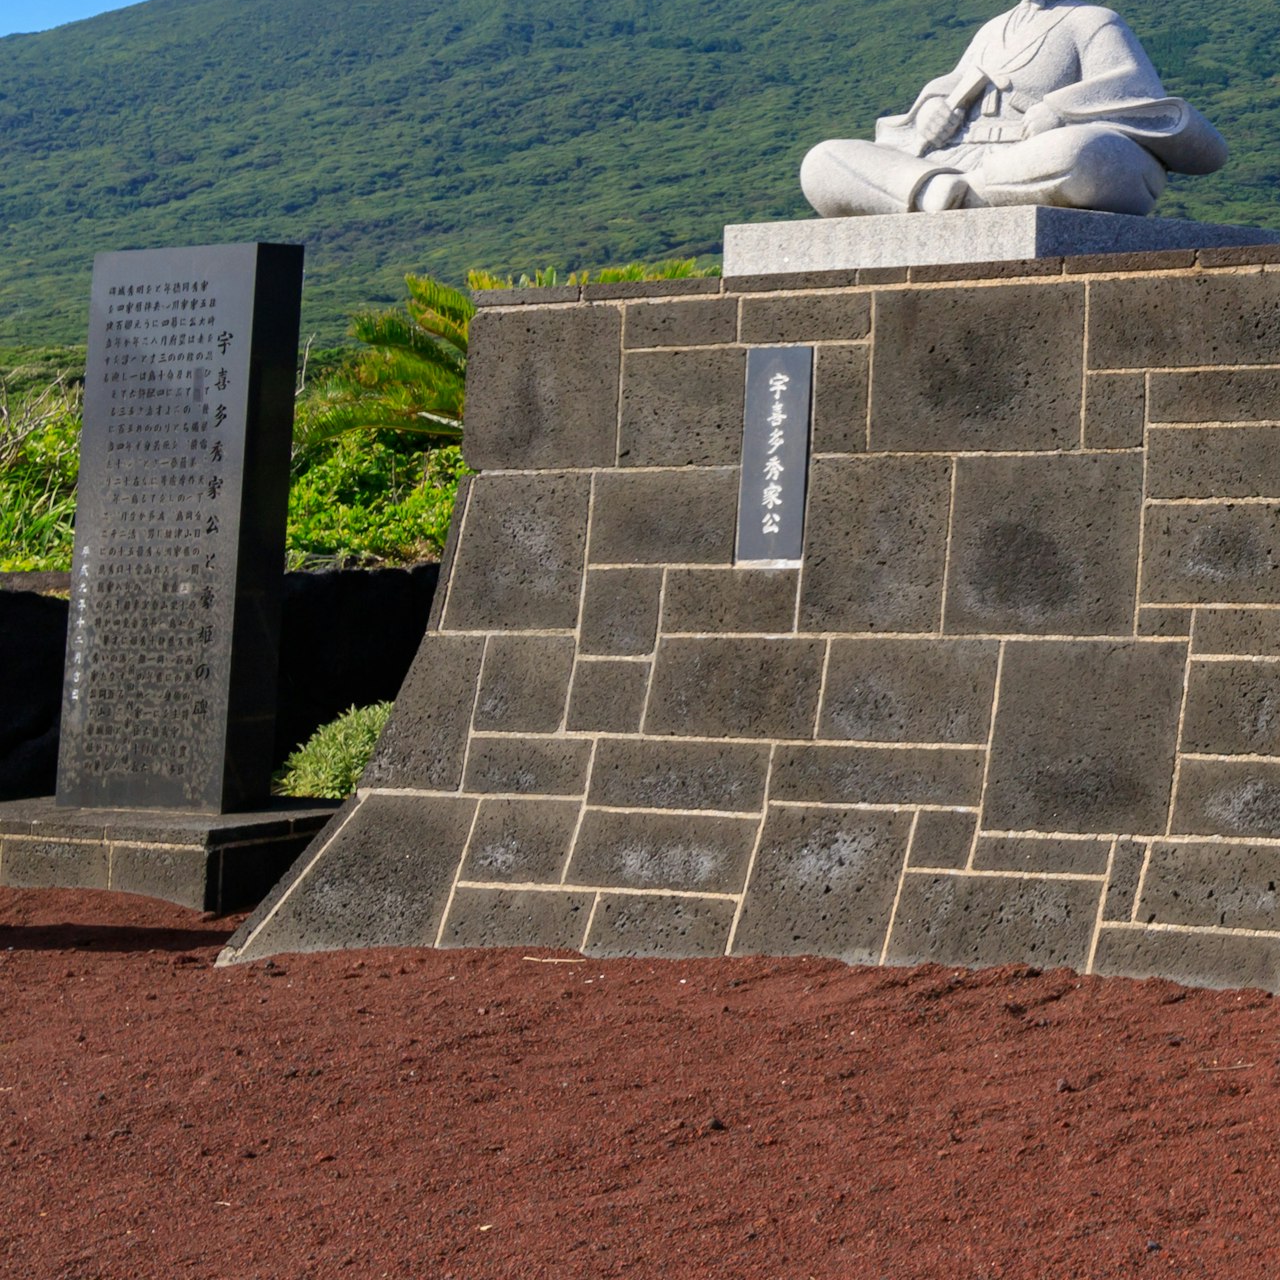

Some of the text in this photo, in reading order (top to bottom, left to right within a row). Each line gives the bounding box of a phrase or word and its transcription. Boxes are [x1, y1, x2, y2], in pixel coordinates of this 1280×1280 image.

[192, 331, 232, 719] 宇喜多秀家公と豪姫の碑
[762, 373, 789, 534] 宇喜多秀家公
